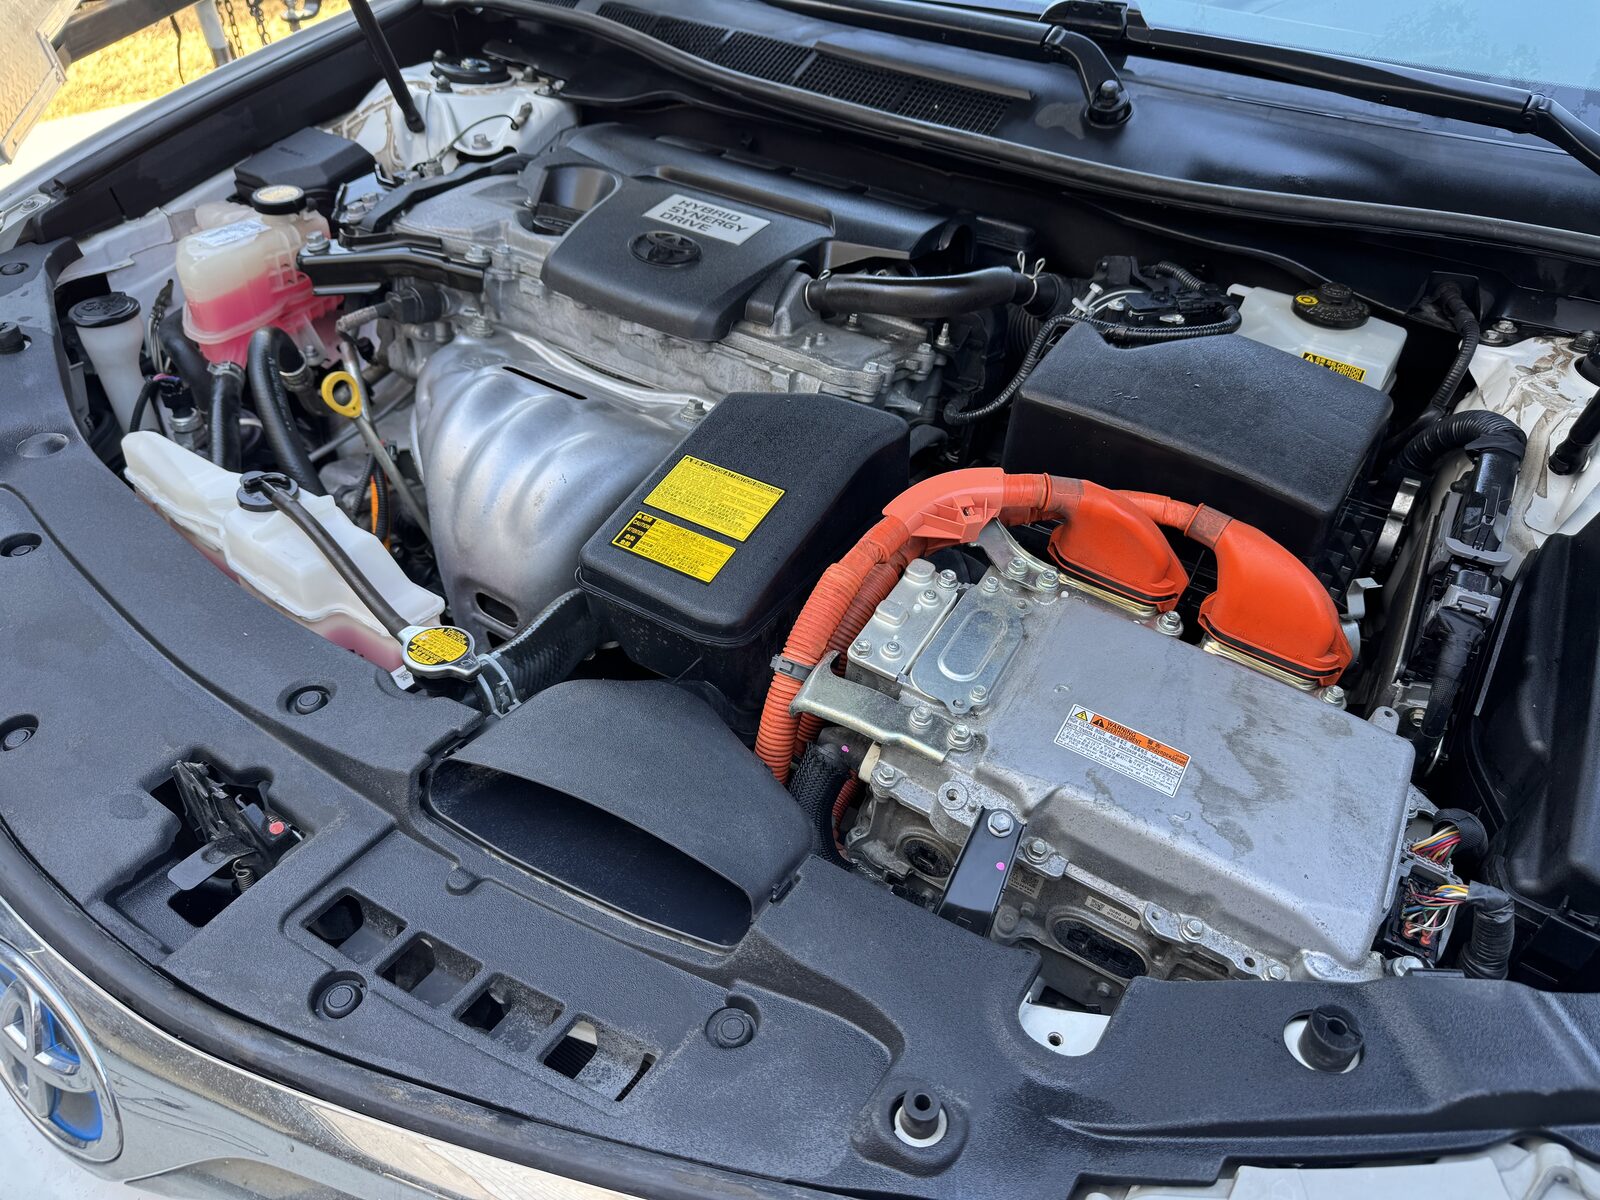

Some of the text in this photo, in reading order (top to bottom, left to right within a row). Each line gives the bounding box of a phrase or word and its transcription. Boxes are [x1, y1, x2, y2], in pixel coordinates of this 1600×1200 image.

[668, 206, 749, 232] SYNERGY
[678, 200, 742, 222] HYBRID
[660, 212, 712, 232] DRIVE
[1329, 366, 1360, 380] ATTENTION
[1337, 363, 1362, 374] CAUTION
[633, 520, 650, 529] CAUTION
[1106, 721, 1136, 737] WARNING
